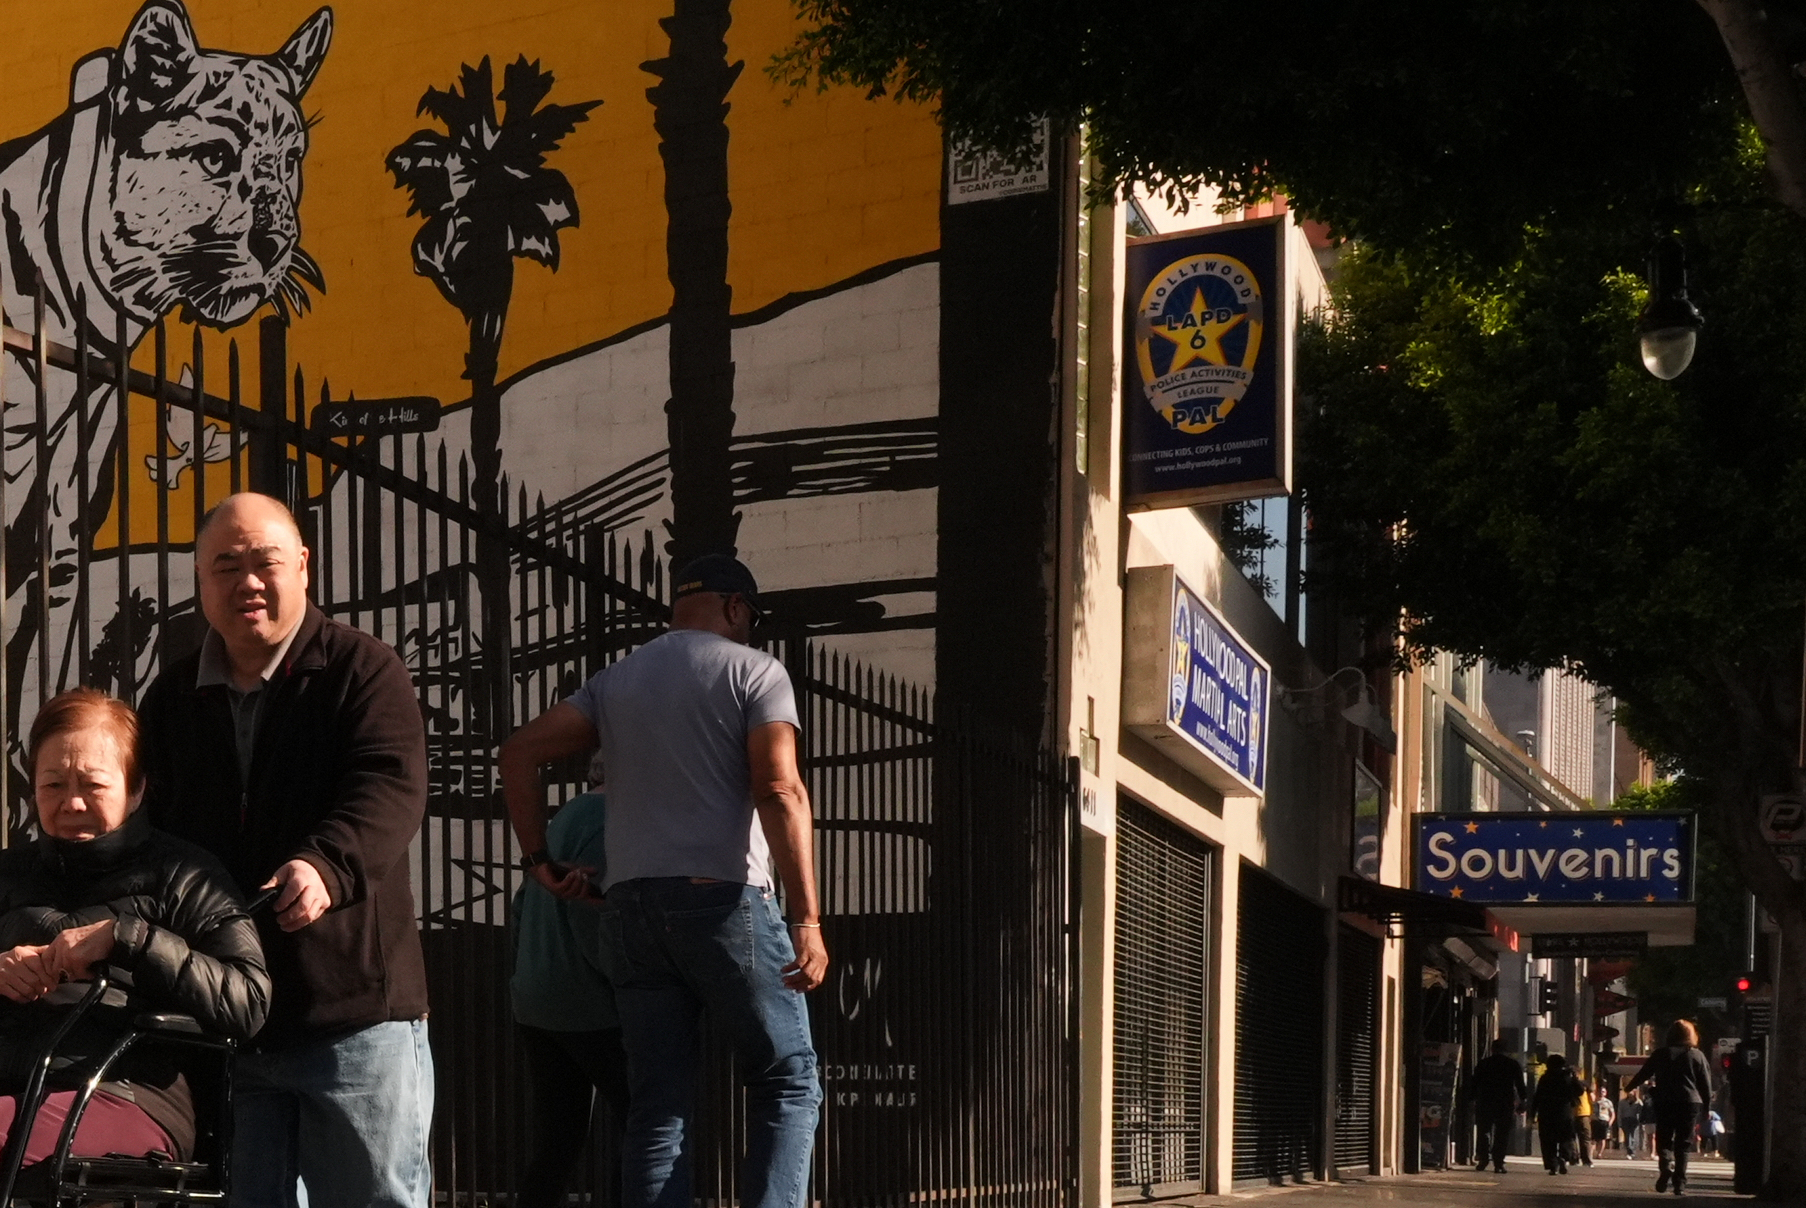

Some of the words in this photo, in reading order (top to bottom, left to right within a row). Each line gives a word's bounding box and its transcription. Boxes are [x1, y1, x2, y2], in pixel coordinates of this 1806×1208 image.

[959, 183, 990, 195] SCAN
[993, 178, 1015, 189] FOR
[1022, 174, 1037, 185] AR
[1149, 261, 1252, 311] HOLLYWOOD
[1166, 307, 1233, 331] LAPD
[1190, 329, 1207, 350] 6
[1150, 372, 1187, 392] POLICE
[1190, 368, 1247, 380] ACTIVITIES
[1177, 385, 1220, 399] LEAGUE
[1171, 404, 1226, 430] PAL
[1129, 450, 1174, 462] CONNECTING
[1175, 447, 1194, 457] KIDS,
[1195, 444, 1214, 455] COPS
[1215, 443, 1222, 452] &
[1222, 437, 1269, 451] COMMUNITY
[1154, 456, 1242, 473] www.hollywoodpal.org
[1194, 611, 1235, 688] HOLLYWOOD
[1235, 657, 1250, 701] PAL
[1192, 664, 1226, 731] MARTIAL
[1227, 699, 1247, 747] ARTS
[1426, 831, 1681, 880] Souvenirs
